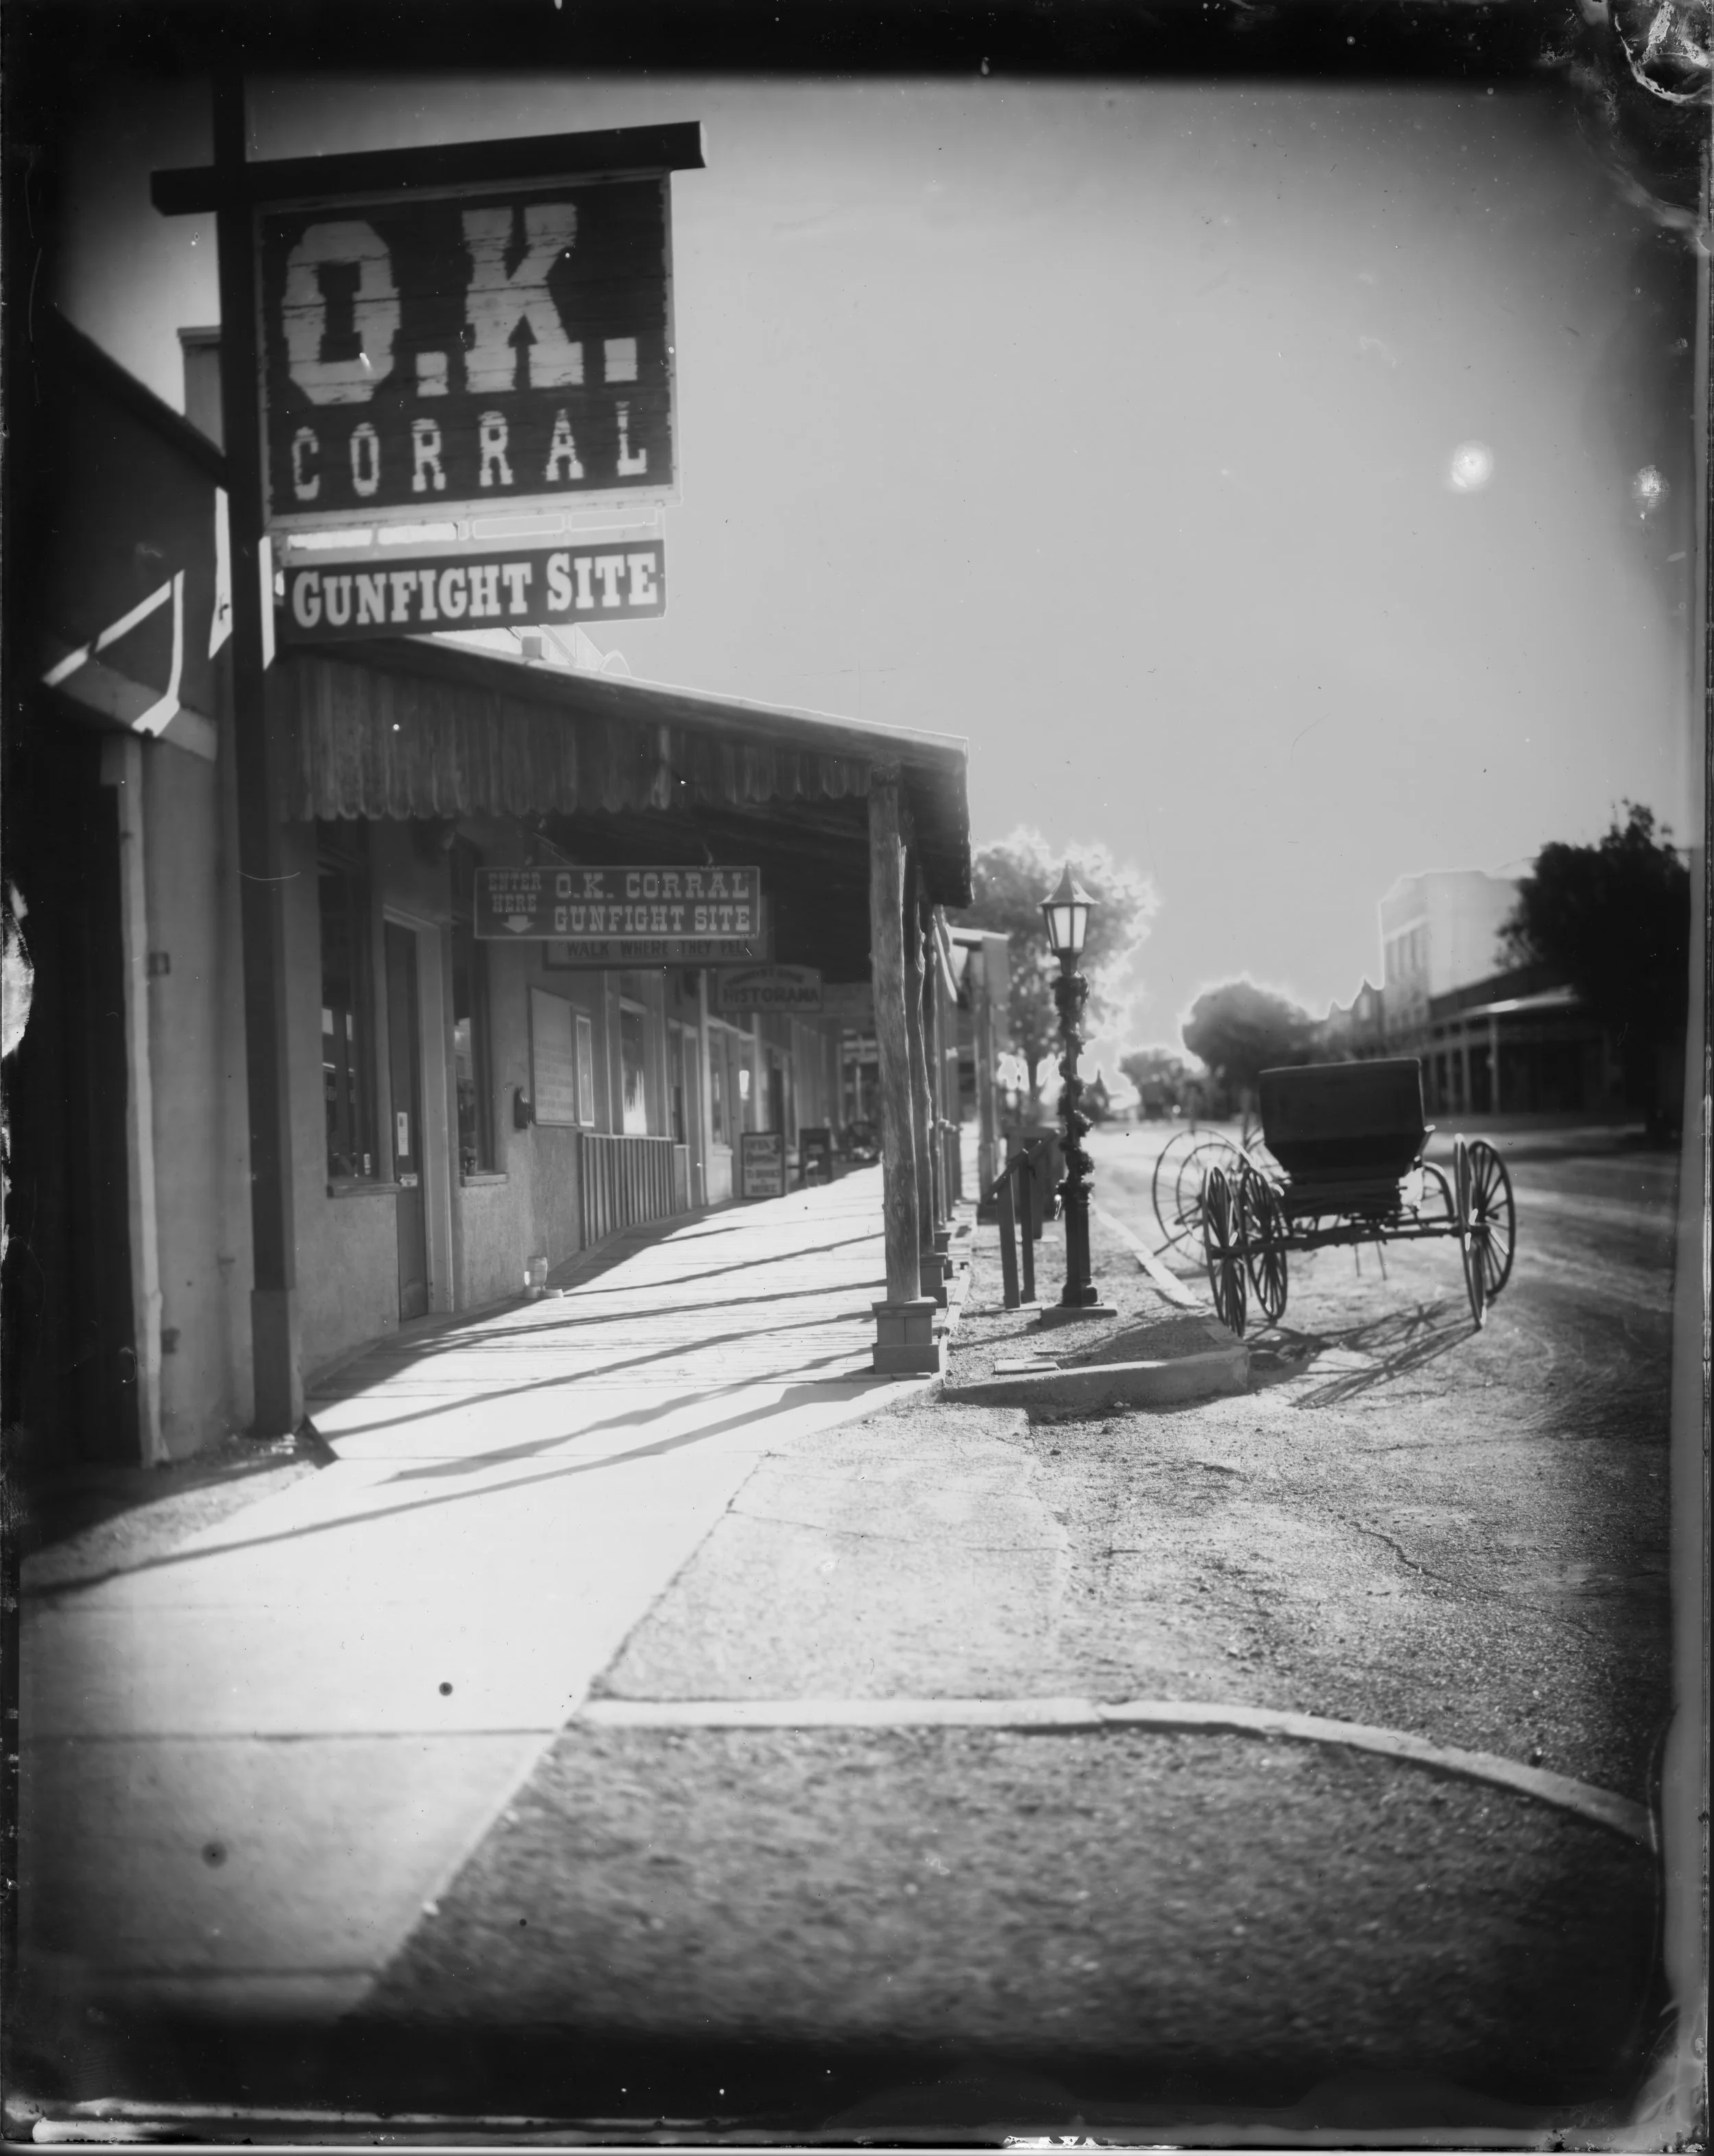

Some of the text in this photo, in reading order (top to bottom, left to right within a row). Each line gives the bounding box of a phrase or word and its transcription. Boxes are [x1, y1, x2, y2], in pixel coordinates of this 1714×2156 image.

[281, 204, 638, 405] O.K.
[292, 401, 647, 501] CORRAL
[293, 552, 658, 627] GUNFIGHT SITE
[487, 872, 542, 891] ENTER
[556, 872, 749, 898] O.K. CORRAL
[492, 894, 537, 913] HERE
[555, 905, 750, 931] GUNFIGHT SITE
[567, 940, 609, 957] WALK
[620, 939, 668, 956] WHERE
[680, 939, 712, 955] THEY
[723, 986, 819, 1003] HISTORAMA
